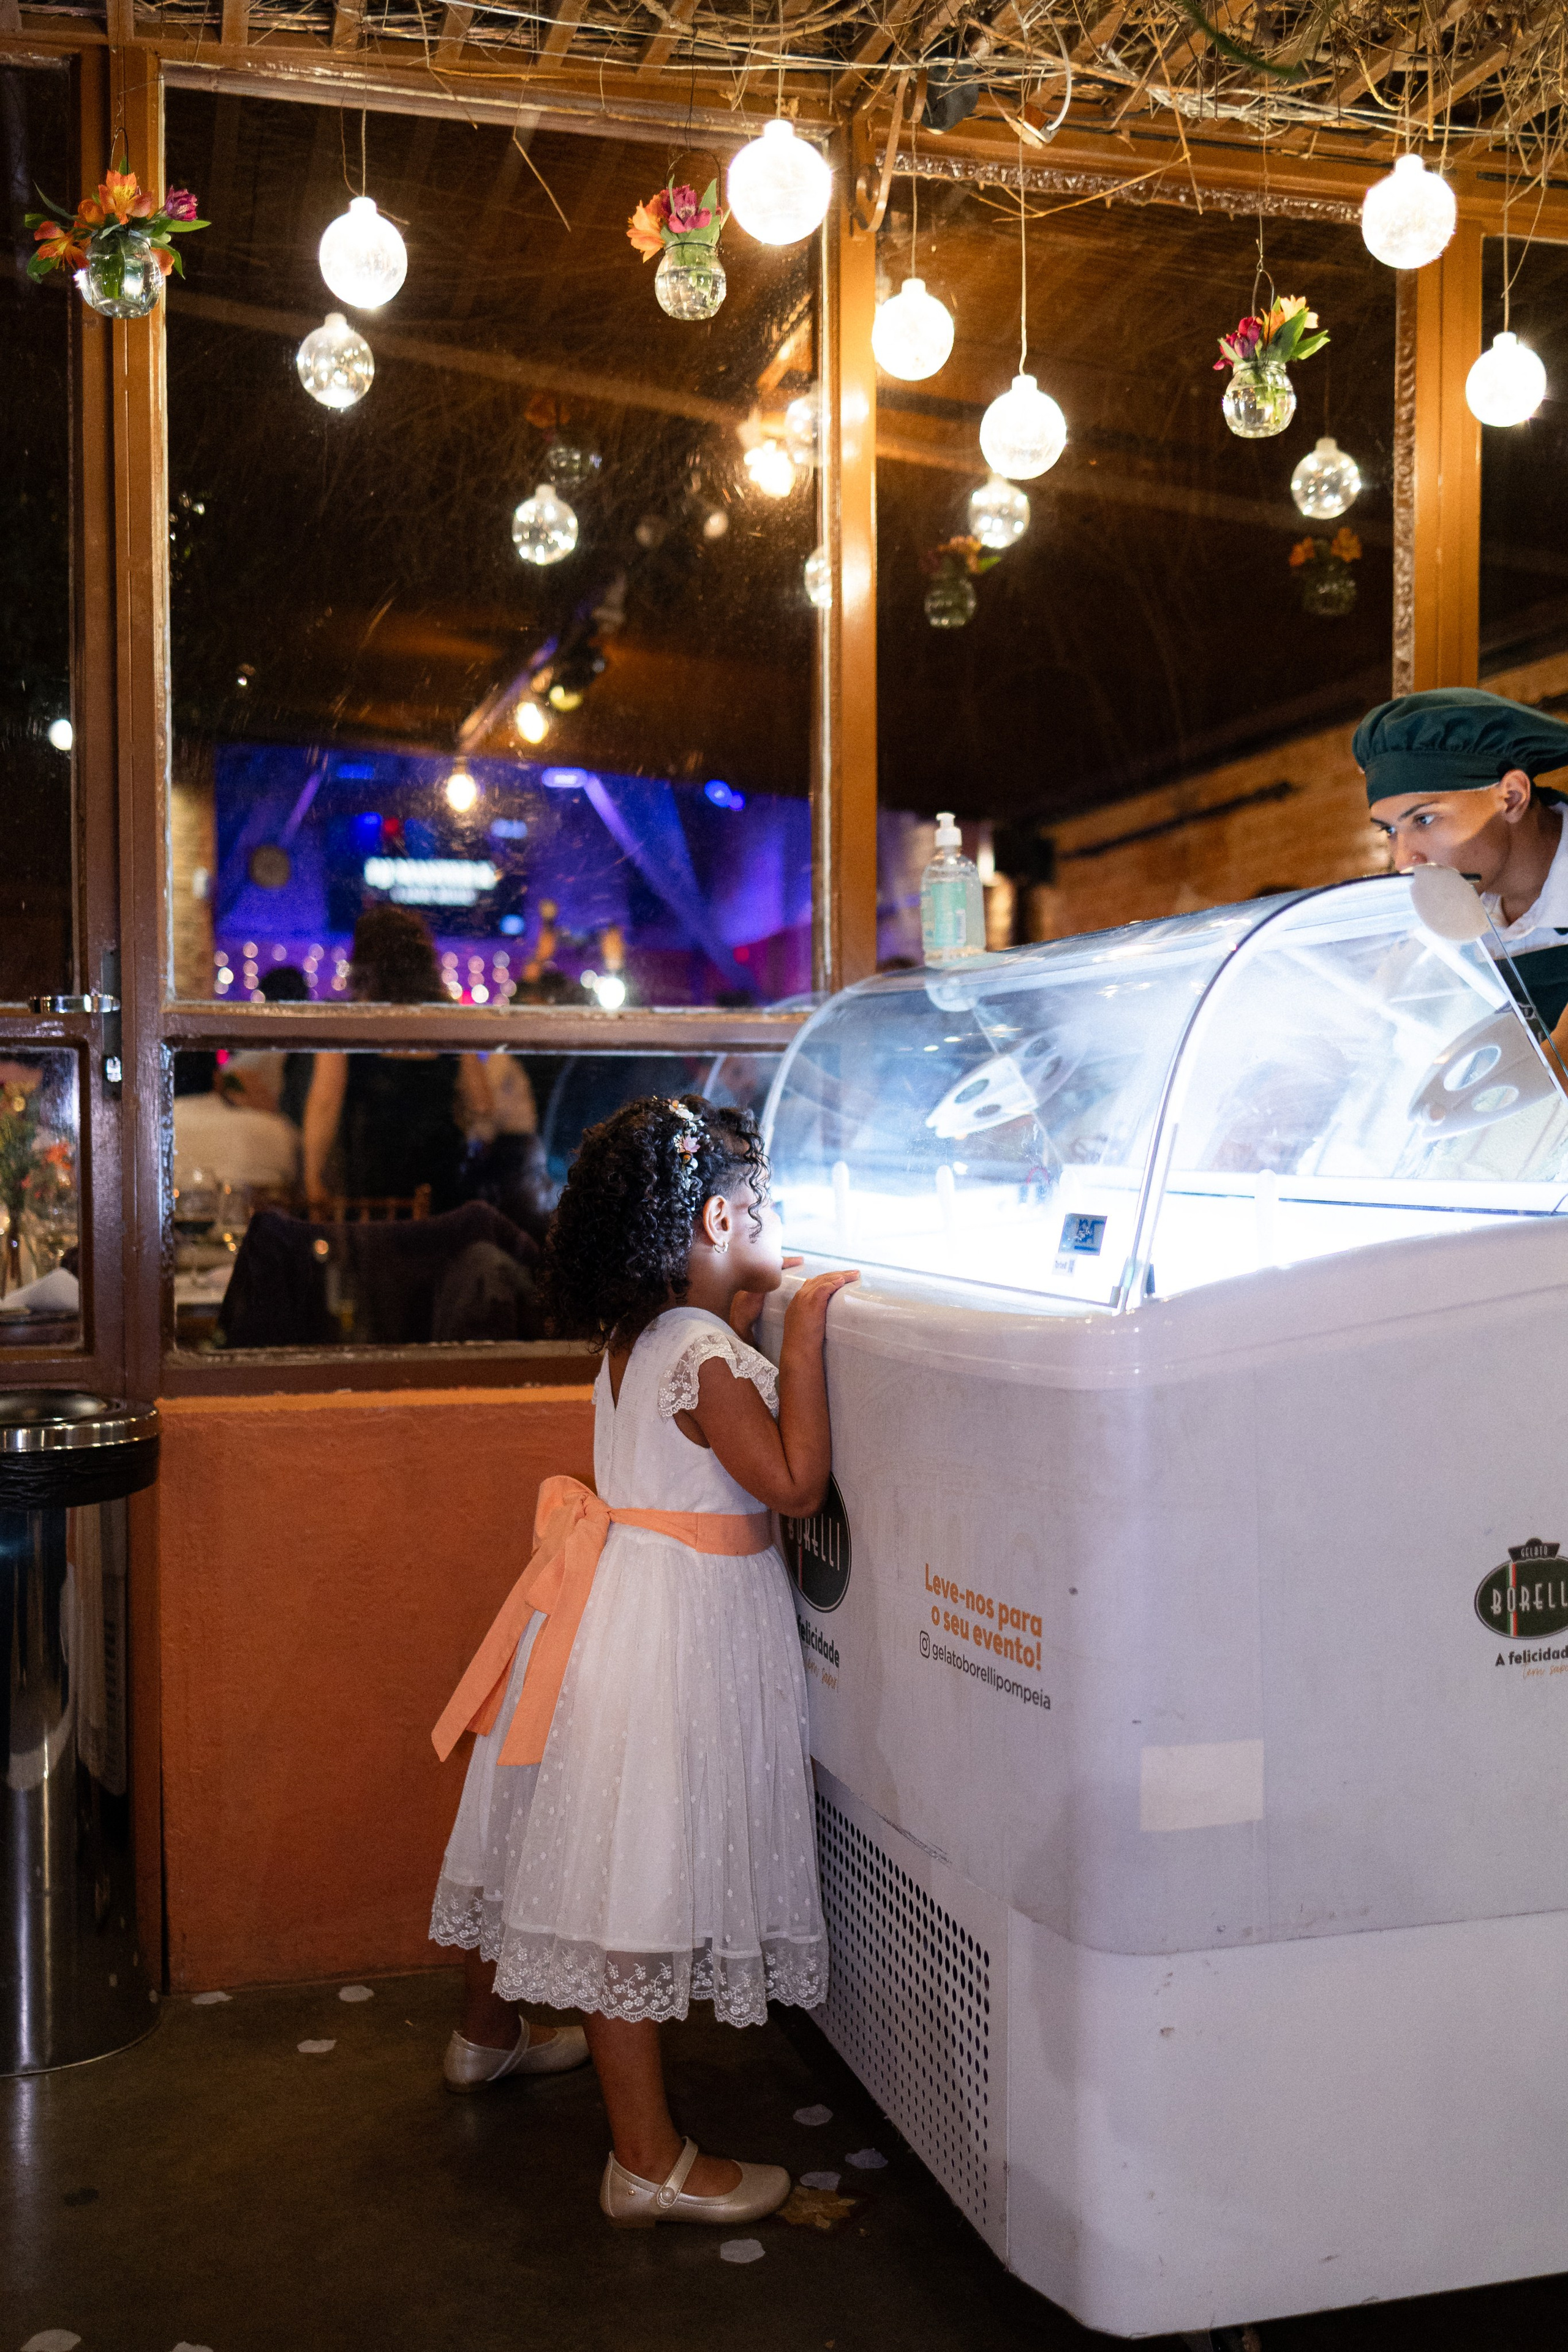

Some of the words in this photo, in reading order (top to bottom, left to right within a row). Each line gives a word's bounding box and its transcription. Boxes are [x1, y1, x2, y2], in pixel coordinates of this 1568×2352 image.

[1520, 1545, 1548, 1558] GELATO
[925, 1562, 994, 1619] Leve-nos
[998, 1602, 1042, 1638] para
[931, 1605, 940, 1626] o
[943, 1611, 969, 1642] seu
[973, 1624, 1041, 1672] evento!
[1495, 1653, 1506, 1667] A
[932, 1643, 1051, 1710] gelatoborellipompeia
